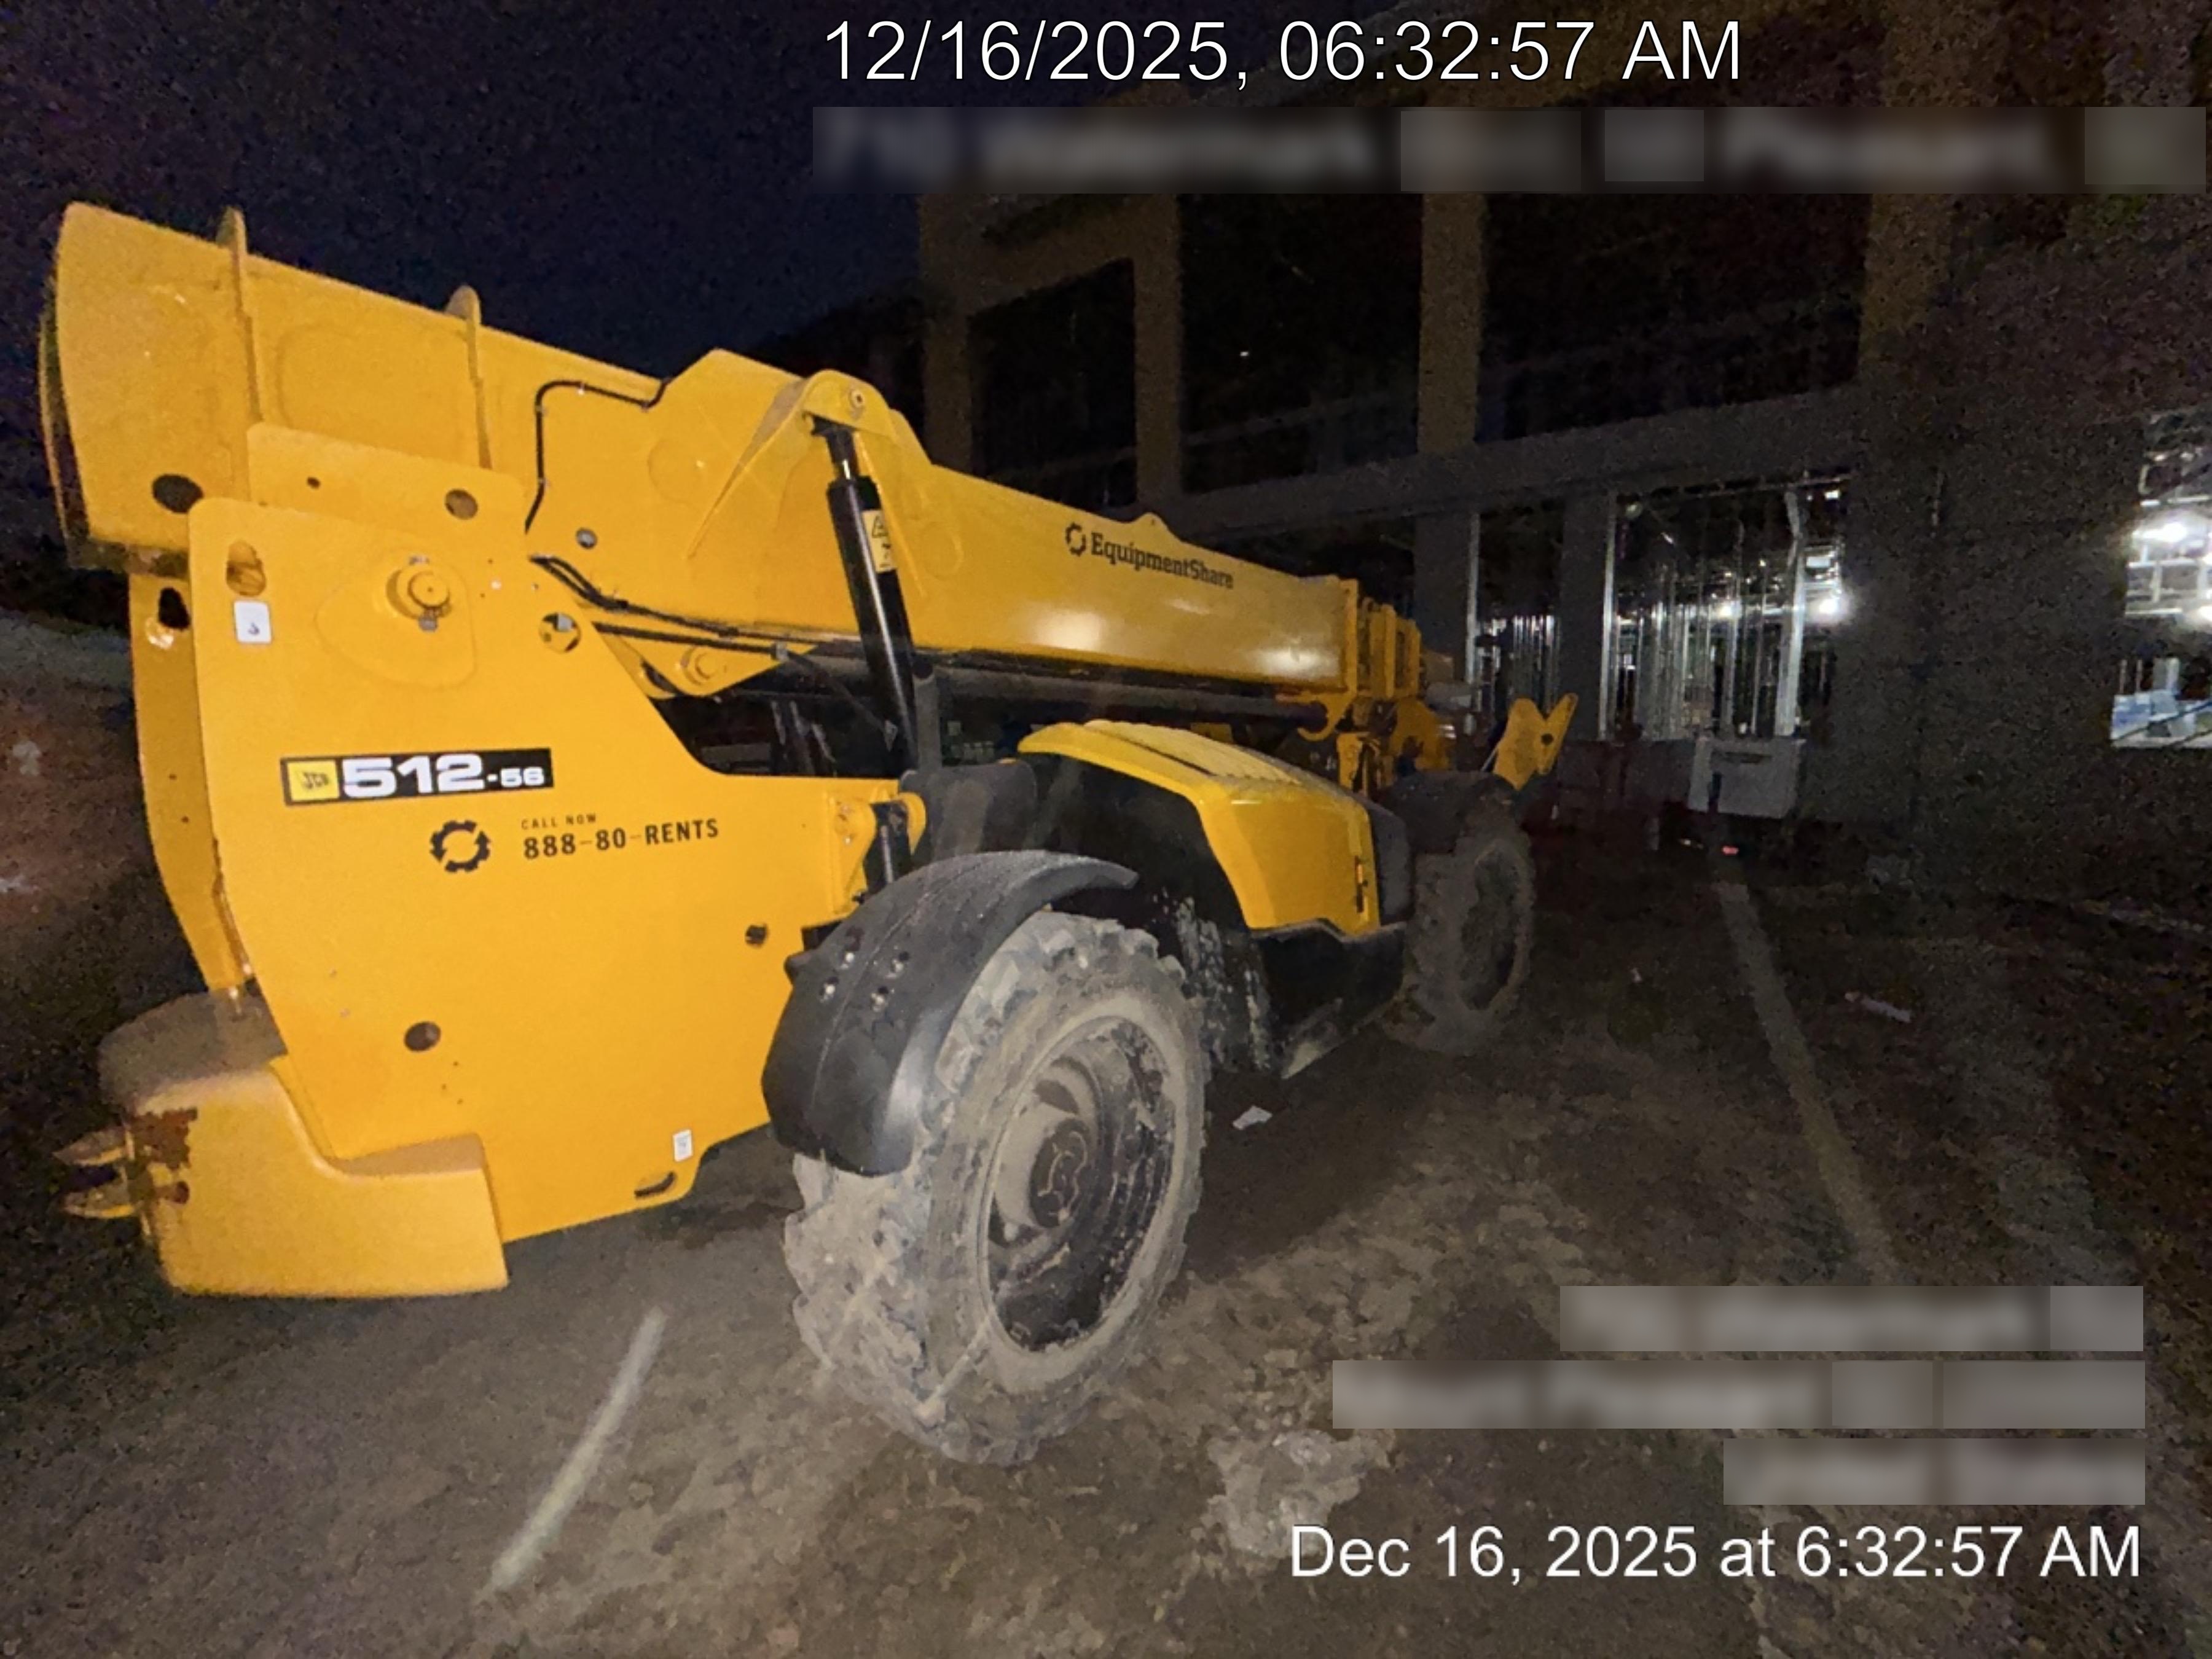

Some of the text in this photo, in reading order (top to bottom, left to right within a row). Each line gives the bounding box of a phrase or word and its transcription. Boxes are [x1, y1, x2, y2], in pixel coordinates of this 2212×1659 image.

[1091, 531, 1234, 589] EquipmentShare
[521, 812, 597, 830] CALL NOW
[524, 818, 719, 860] 888-80-RENTS
